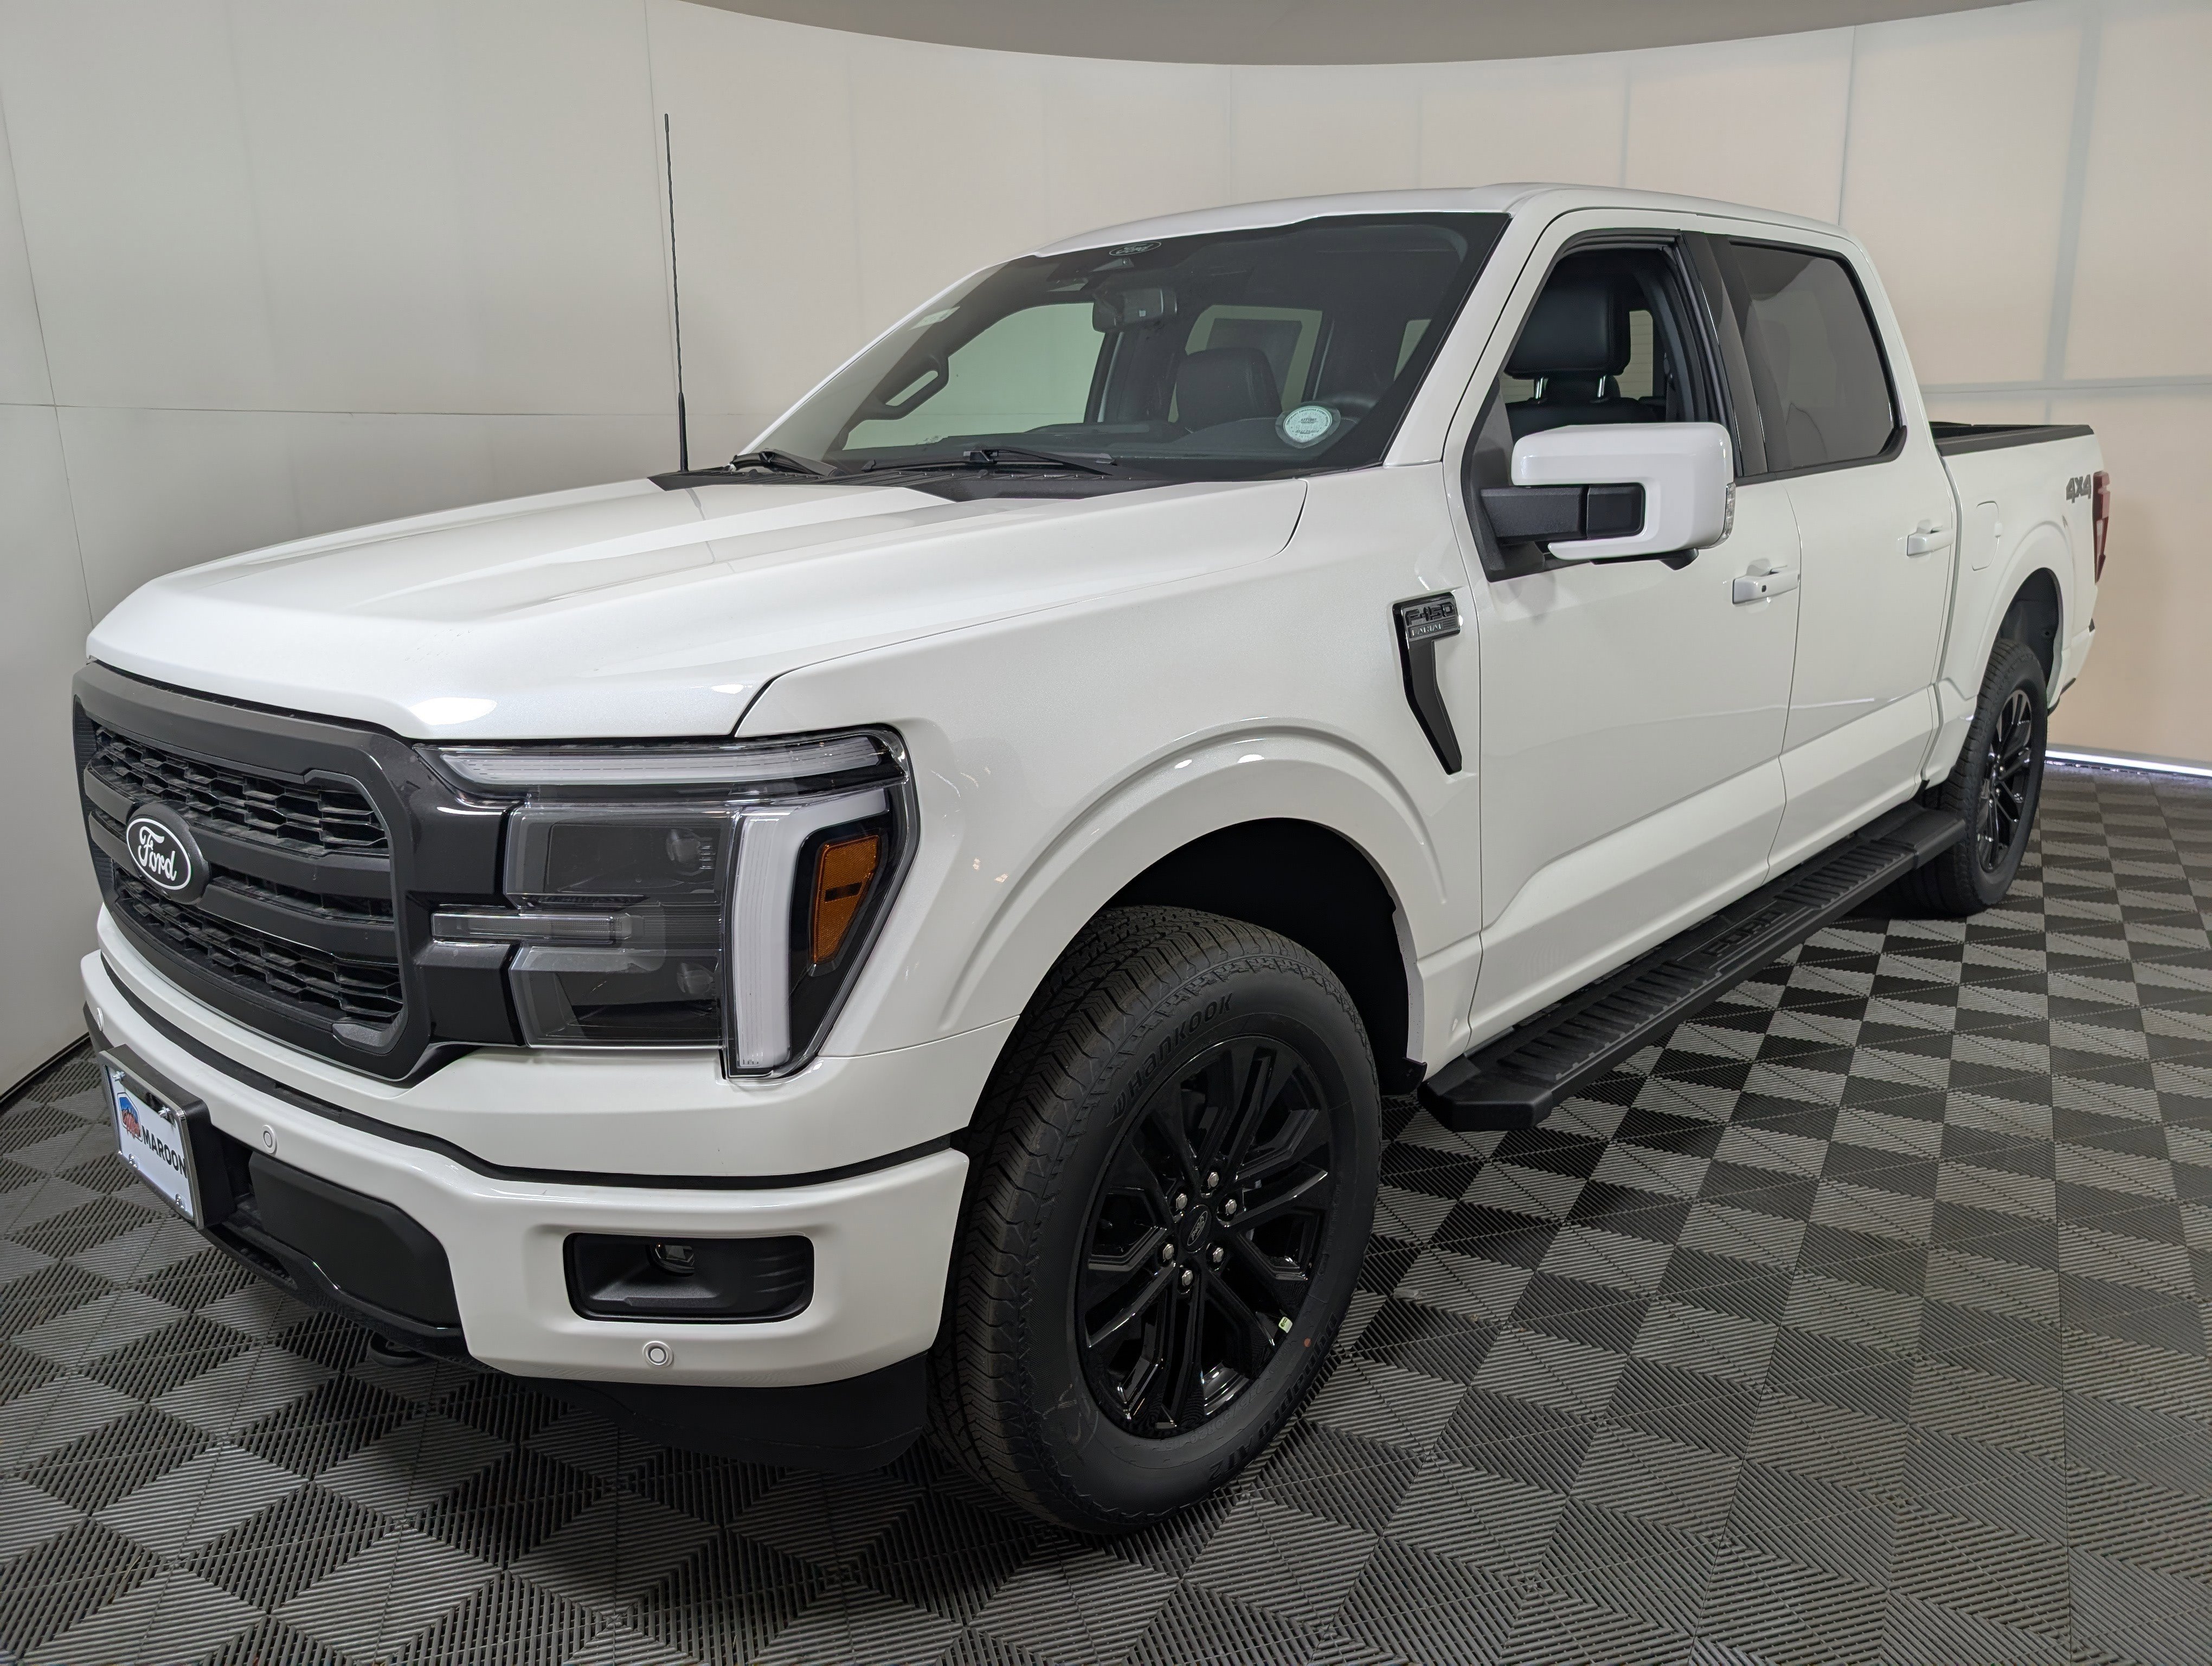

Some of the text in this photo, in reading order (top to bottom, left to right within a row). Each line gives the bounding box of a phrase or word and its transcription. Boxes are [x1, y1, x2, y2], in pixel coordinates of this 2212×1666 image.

[1116, 242, 1154, 254] Ford
[1405, 601, 1455, 626] F-150
[138, 826, 177, 881] Ford
[1701, 910, 1787, 958] FORD
[142, 1125, 188, 1179] MAROON
